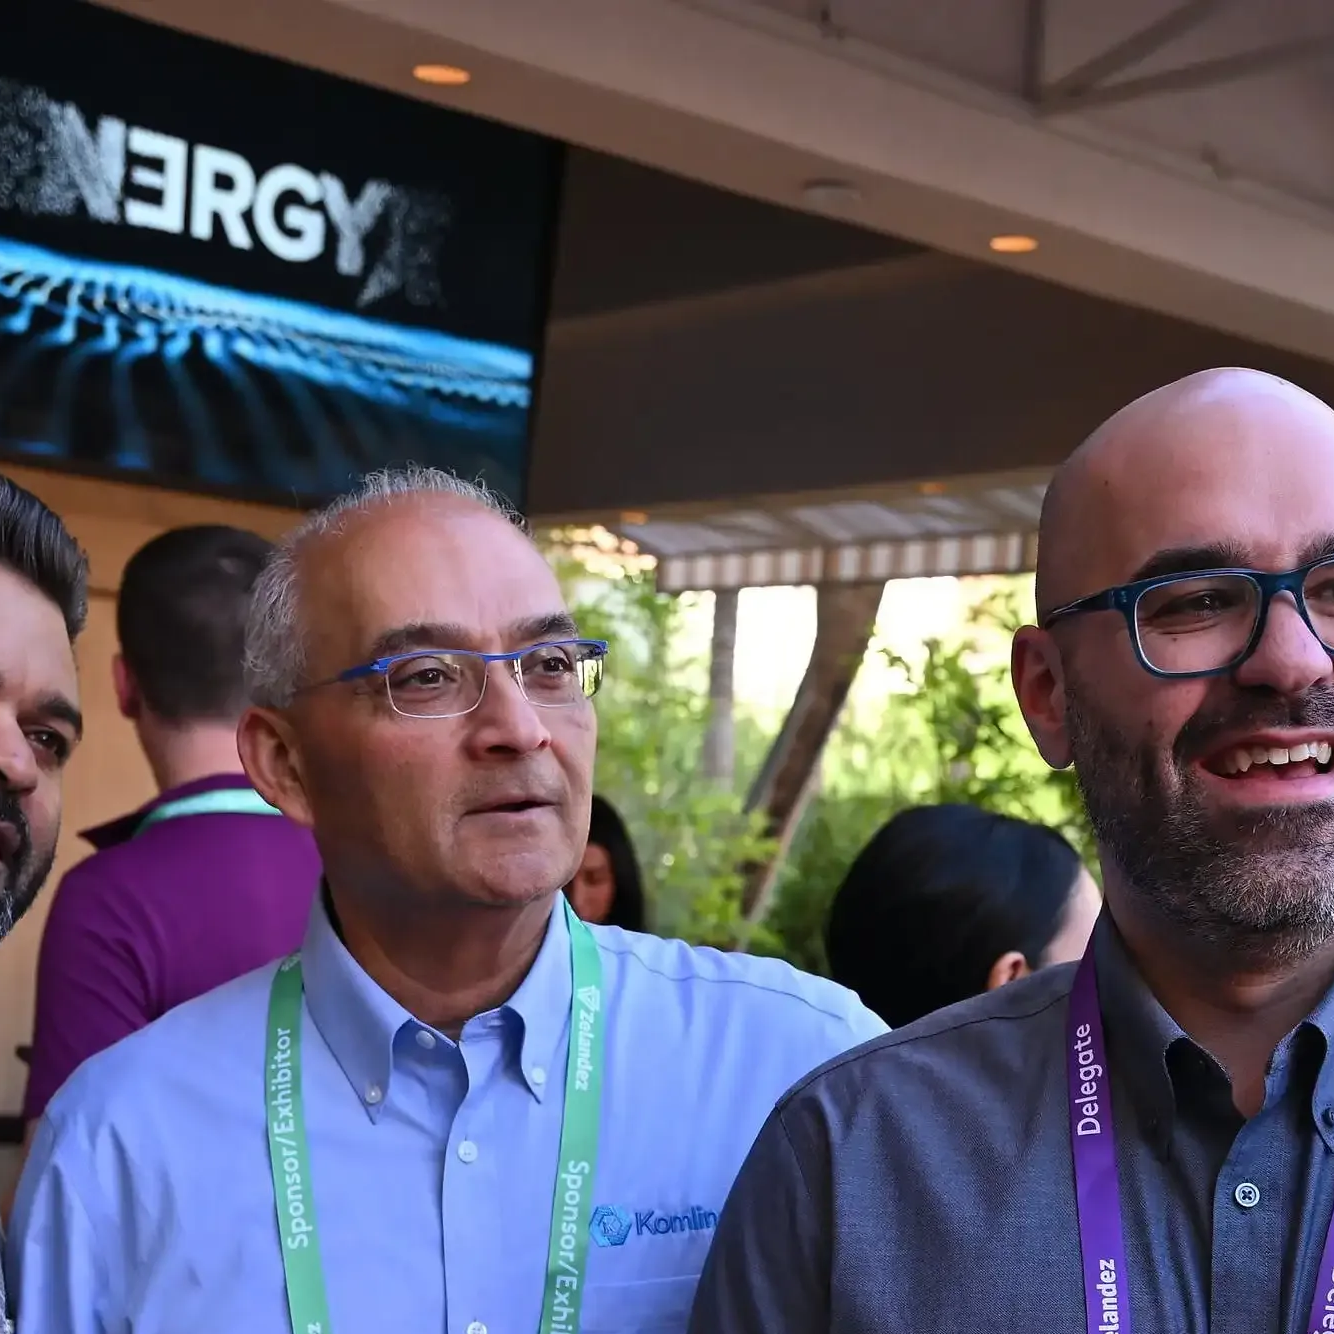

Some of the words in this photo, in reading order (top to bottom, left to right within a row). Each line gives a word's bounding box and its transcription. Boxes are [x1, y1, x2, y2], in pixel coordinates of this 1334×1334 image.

[1073, 1022, 1105, 1137] Delegate
[269, 1026, 312, 1249] Sponsor/Exhibitor
[634, 1204, 718, 1236] Komlin
